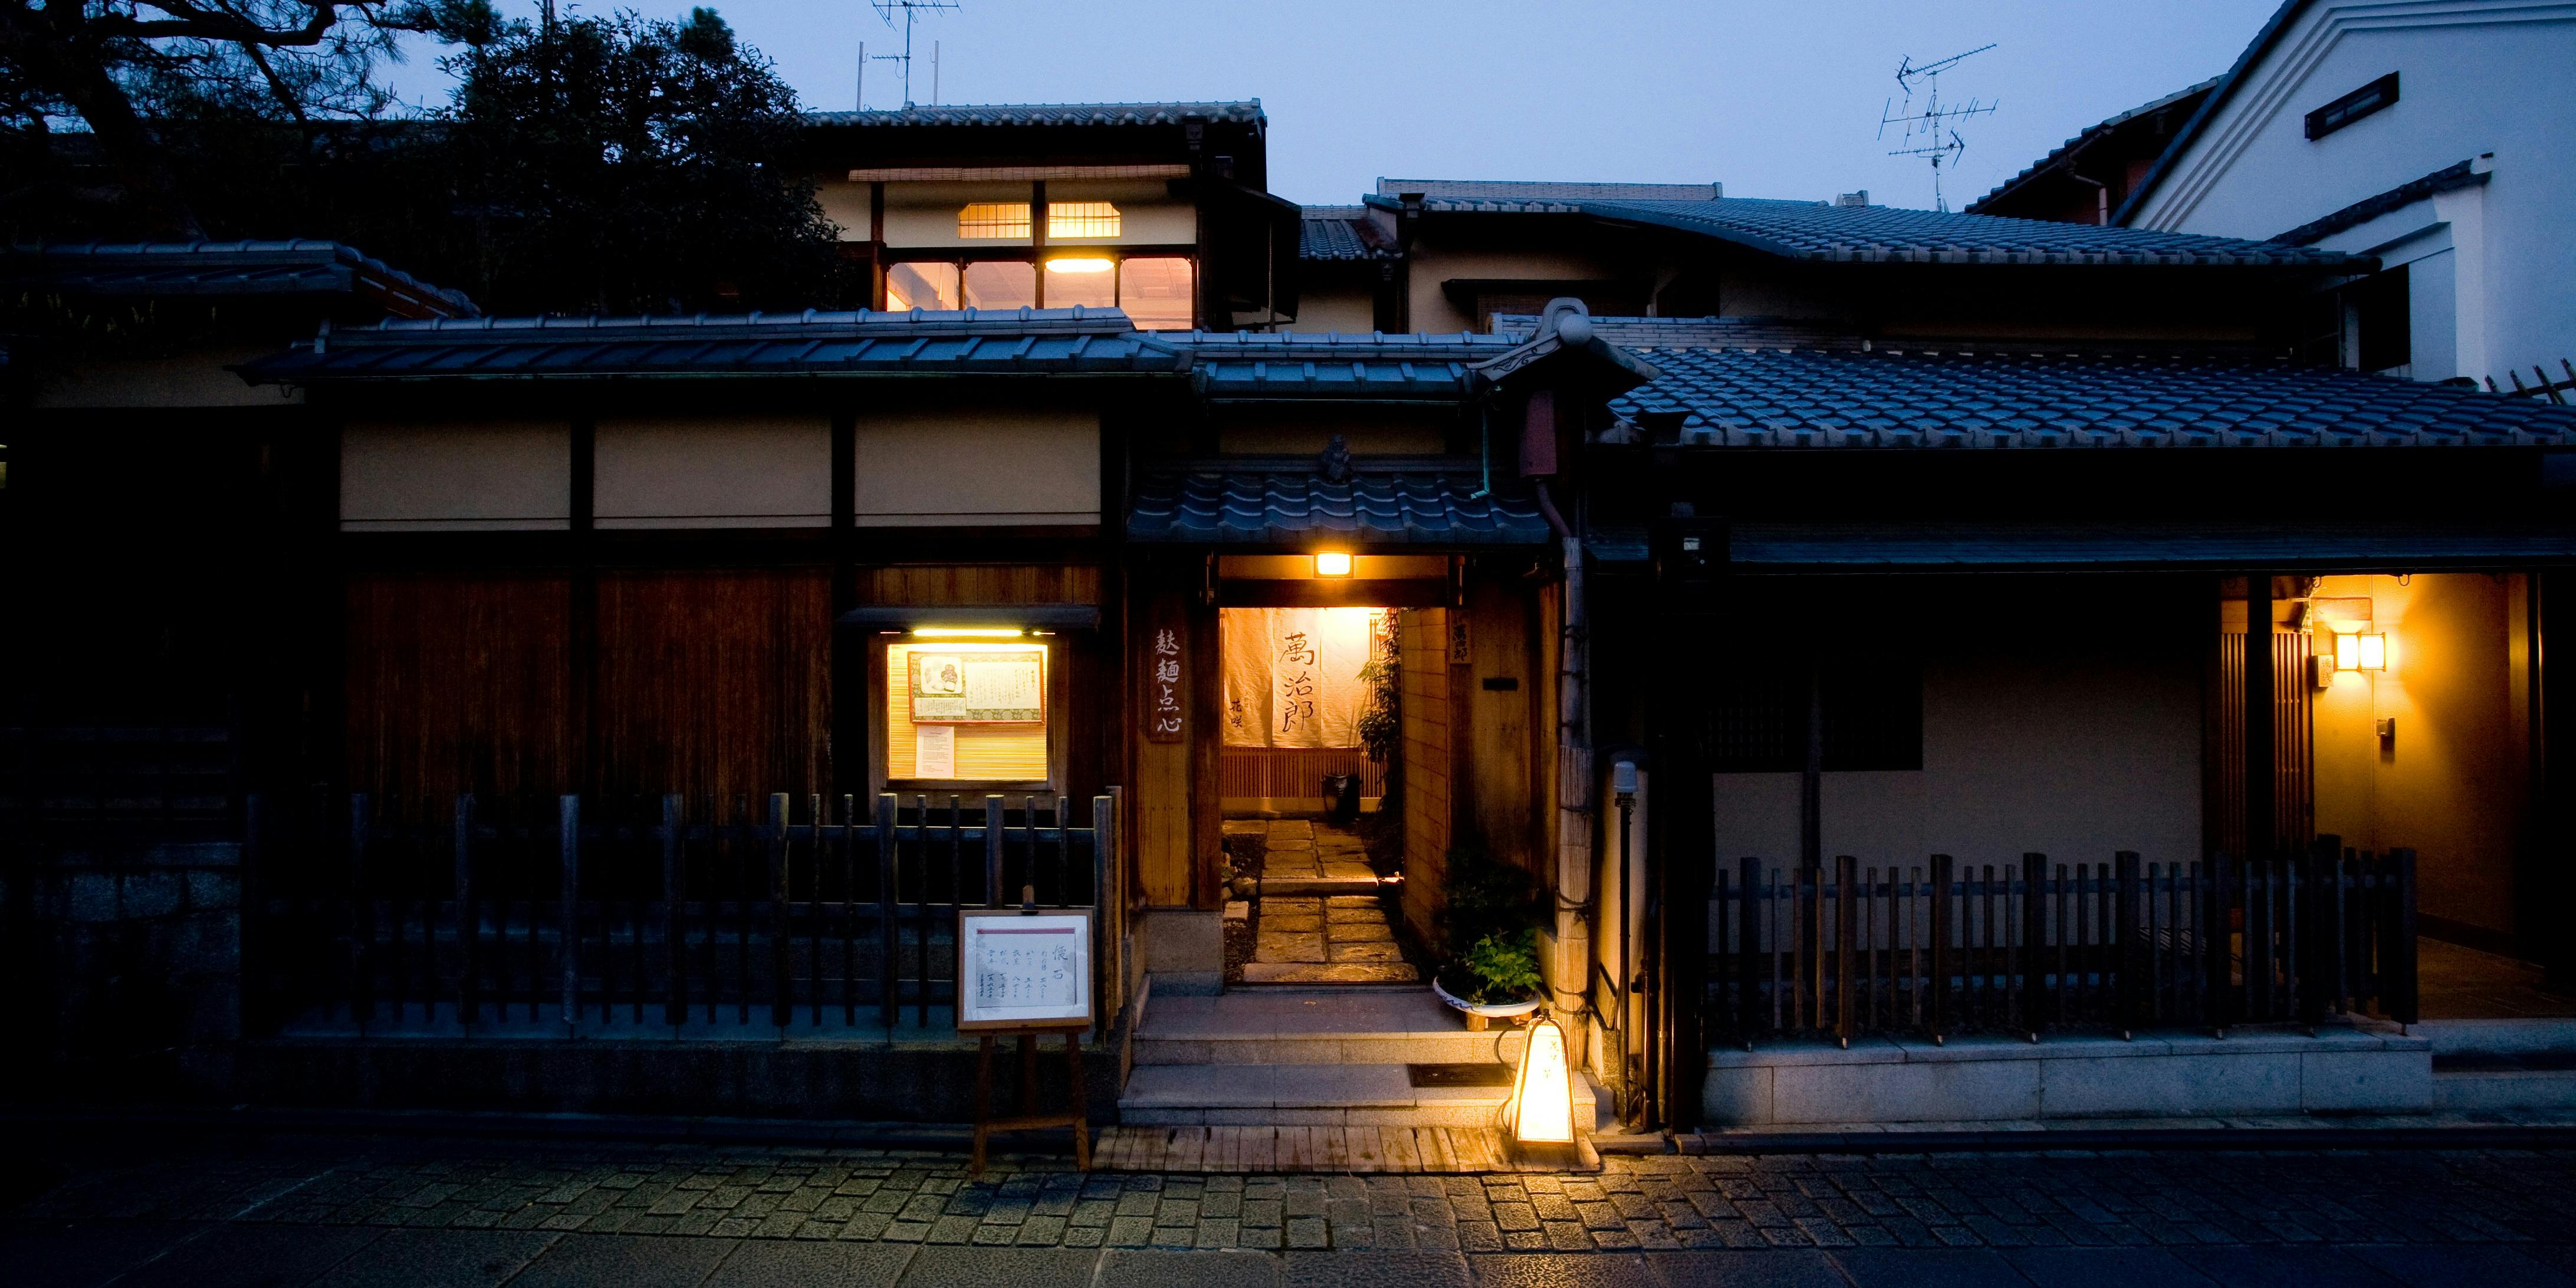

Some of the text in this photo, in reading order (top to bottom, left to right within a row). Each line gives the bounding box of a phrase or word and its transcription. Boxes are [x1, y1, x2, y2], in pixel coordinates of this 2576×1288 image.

[1230, 698, 1243, 728] 花咲
[1279, 632, 1315, 732] 萬治郎
